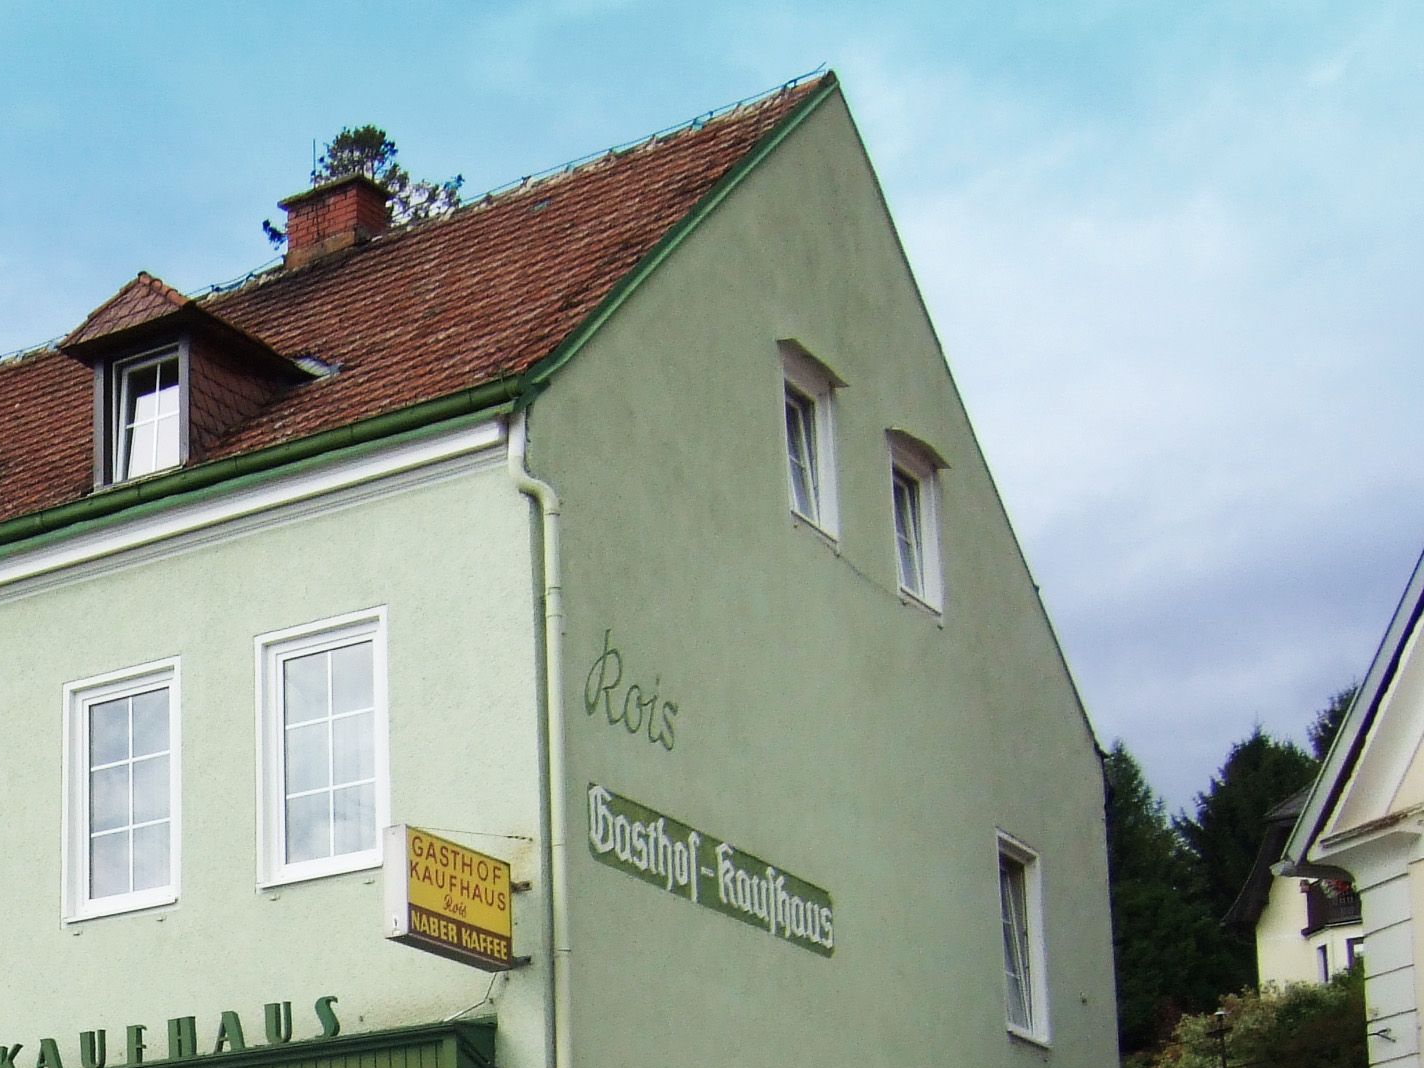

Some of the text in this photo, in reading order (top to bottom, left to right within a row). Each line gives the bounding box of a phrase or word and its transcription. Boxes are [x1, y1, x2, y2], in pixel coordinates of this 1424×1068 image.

[583, 628, 679, 752] Rois
[411, 836, 502, 885] GASTHOF
[409, 860, 507, 912] KAUFHAUS
[443, 894, 468, 918] Rois
[411, 910, 508, 960] NABER KAFFEE
